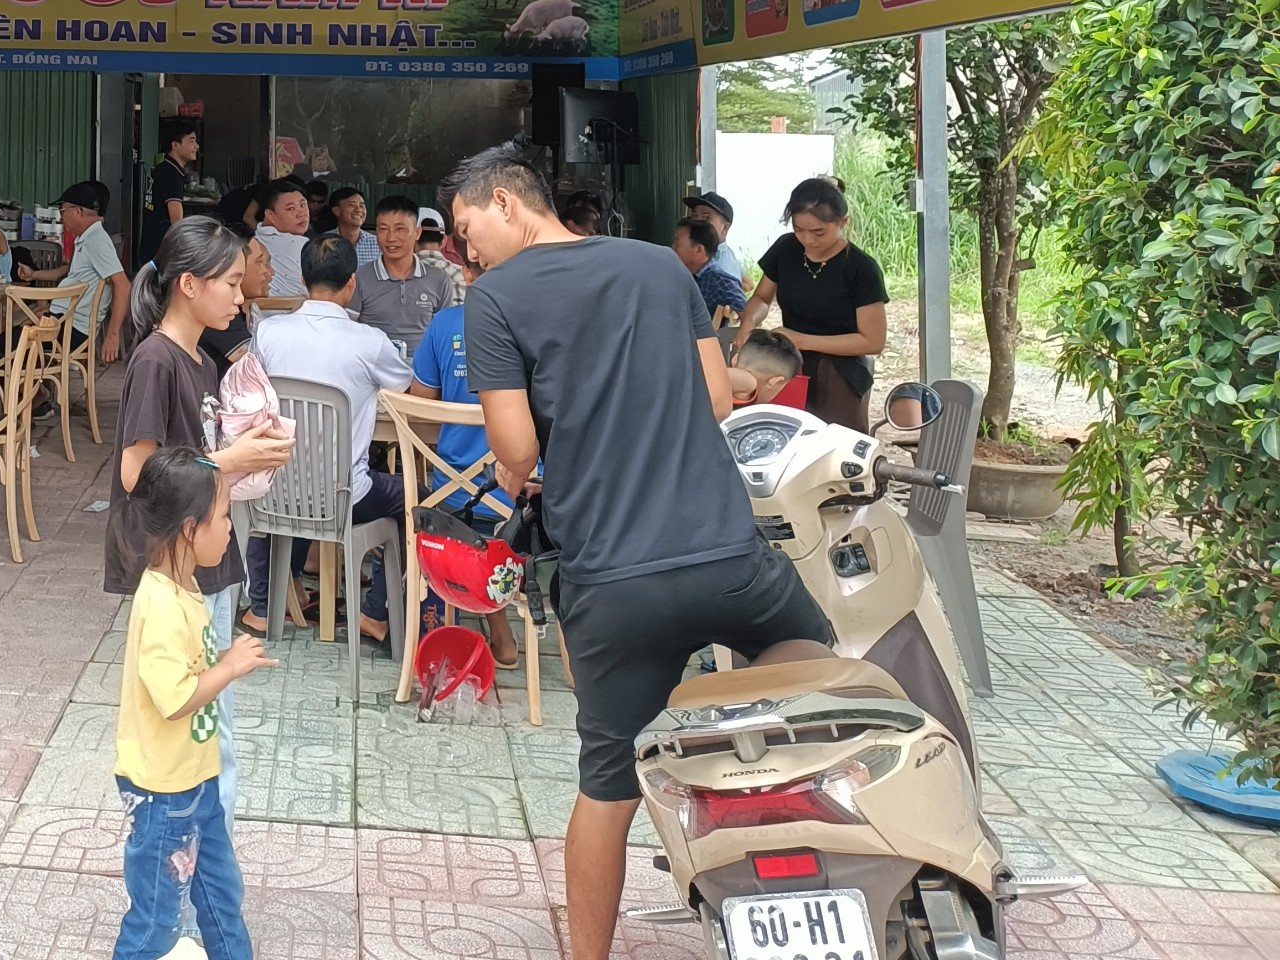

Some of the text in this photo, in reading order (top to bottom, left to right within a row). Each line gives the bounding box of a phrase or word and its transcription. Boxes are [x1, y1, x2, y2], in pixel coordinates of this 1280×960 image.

[55, 19, 167, 43] HOAN
[211, 21, 313, 45] SINH
[67, 54, 98, 65] NAI
[365, 61, 529, 74] ĐT: 0388 350 269
[914, 742, 946, 769] LEAD
[721, 768, 780, 778] HONDA
[748, 900, 845, 948] 60-H1
